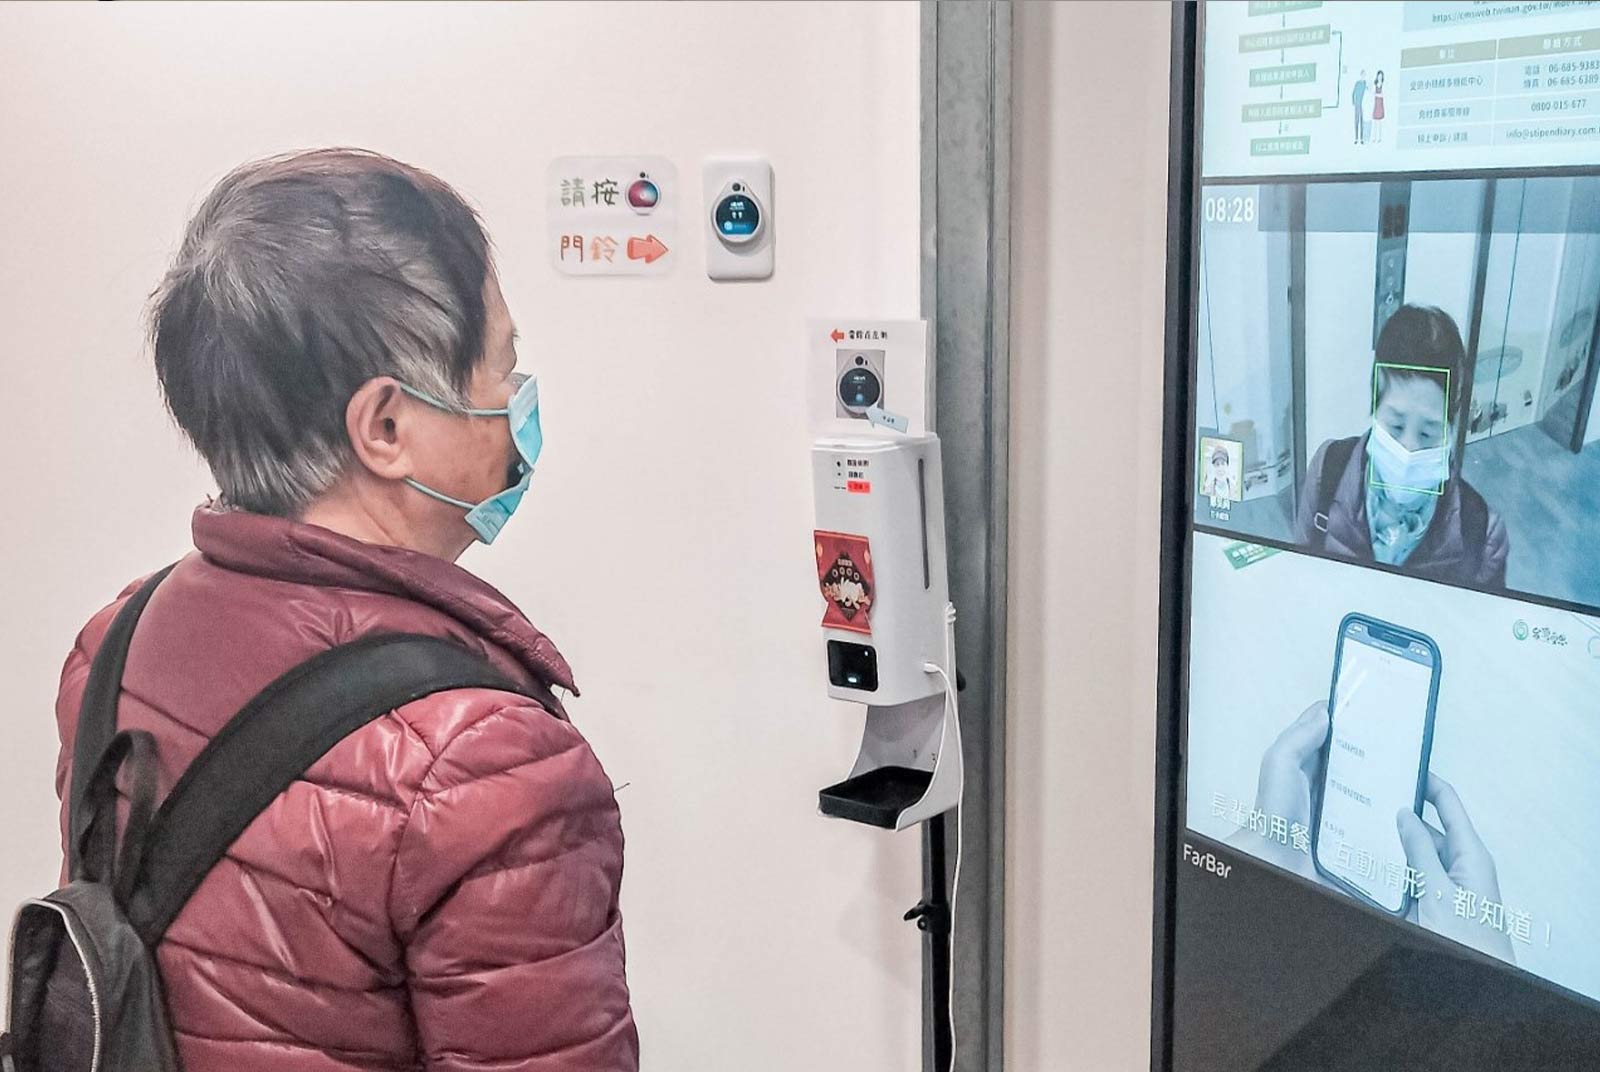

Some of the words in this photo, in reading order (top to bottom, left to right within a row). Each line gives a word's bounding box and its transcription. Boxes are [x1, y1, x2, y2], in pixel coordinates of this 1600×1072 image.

[560, 178, 620, 208] 請按
[1206, 197, 1254, 222] 08:28
[560, 235, 618, 263] 門鈴
[1183, 844, 1232, 879] FarBar
